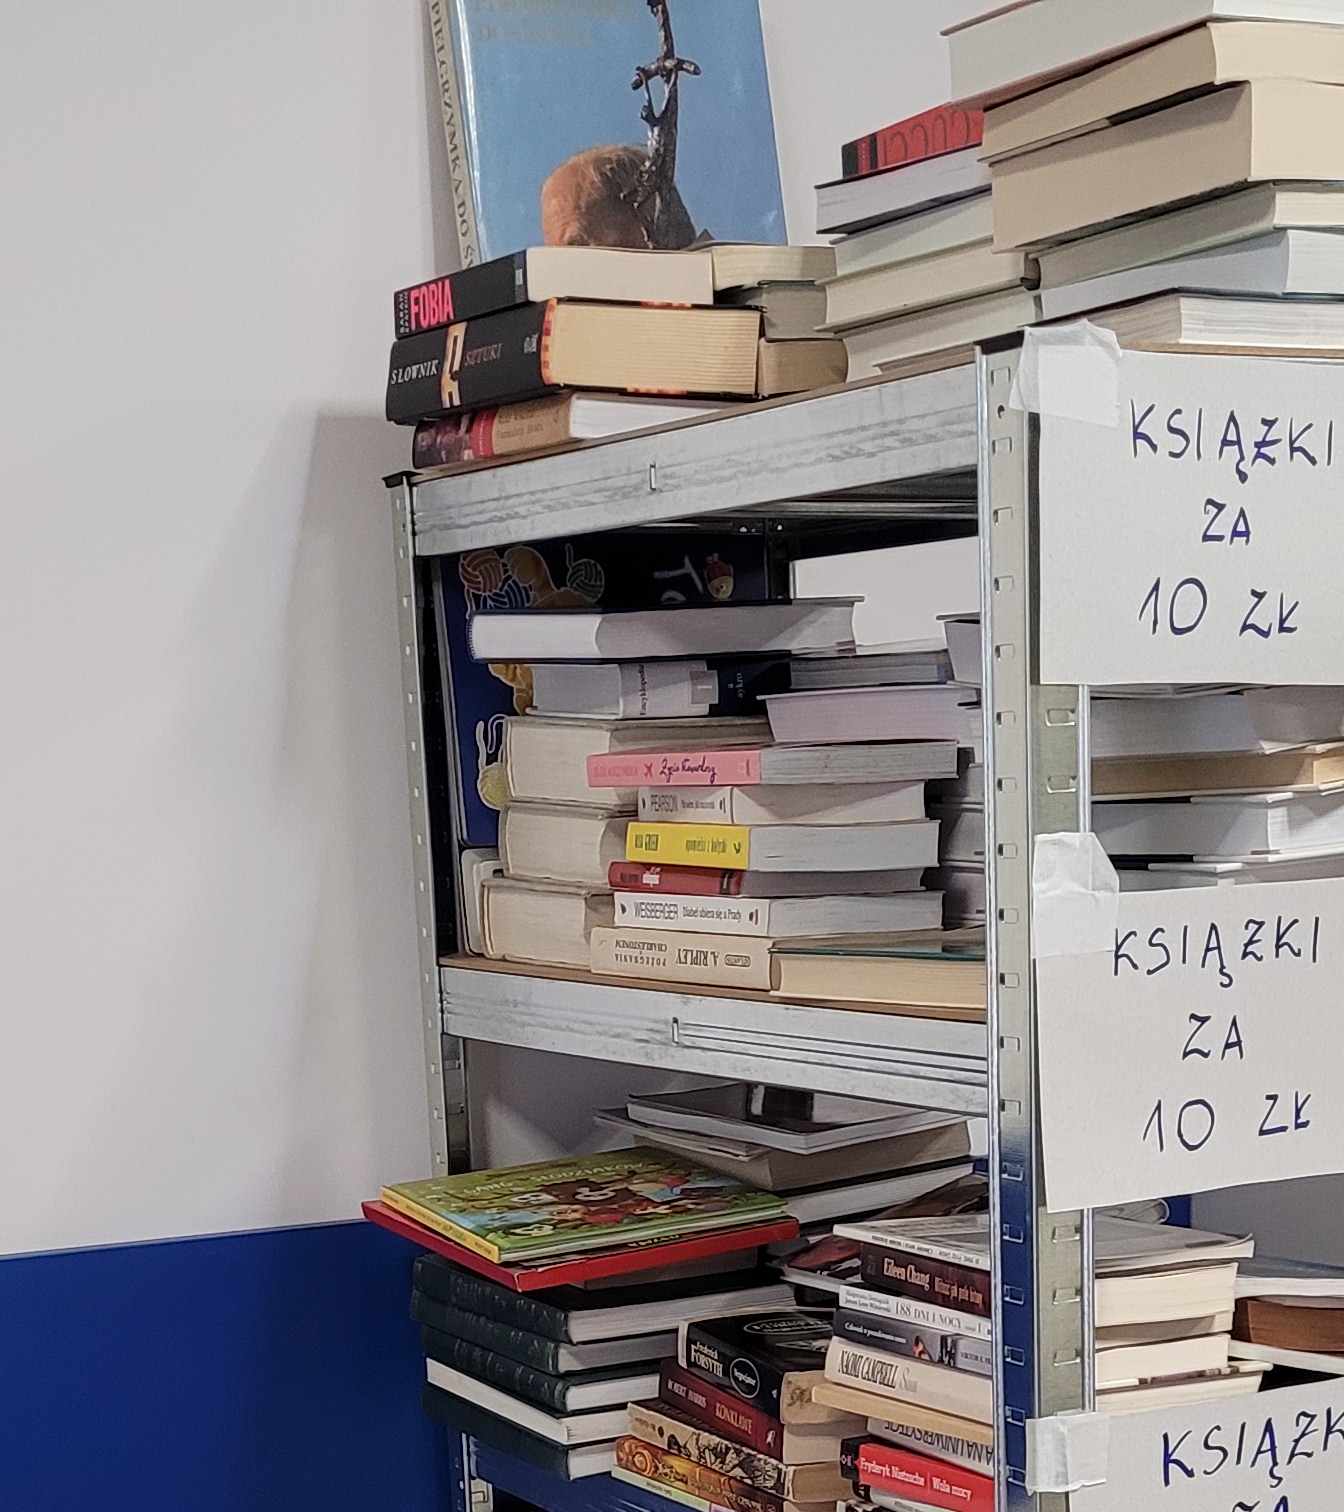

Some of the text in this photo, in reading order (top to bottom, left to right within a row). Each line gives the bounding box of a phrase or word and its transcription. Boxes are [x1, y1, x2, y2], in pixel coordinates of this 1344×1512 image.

[455, 199, 470, 238] DO
[410, 278, 454, 332] FOBIA
[1130, 398, 1334, 483] KSIĄŻKI
[1201, 497, 1252, 546] ZA
[1138, 576, 1208, 636] 10
[633, 901, 679, 921] WEISBERGER
[675, 948, 709, 967] RIPLEY
[1112, 915, 1320, 989] KSIĄŻKI
[1182, 1013, 1244, 1061] ZA
[1143, 1098, 1216, 1152] 10
[882, 1257, 906, 1280] Eileen
[906, 1264, 931, 1291] Chang
[895, 1300, 912, 1317] 188
[913, 1307, 931, 1322] DNI
[938, 1313, 963, 1330] NOCY
[690, 1343, 724, 1379] FORSYTH
[837, 1349, 861, 1379] NAOMI
[861, 1353, 898, 1390] CAMPBELL
[715, 1401, 753, 1436] KONKLAWE
[859, 1456, 891, 1478] Fryderyk
[931, 1476, 951, 1494] Wola
